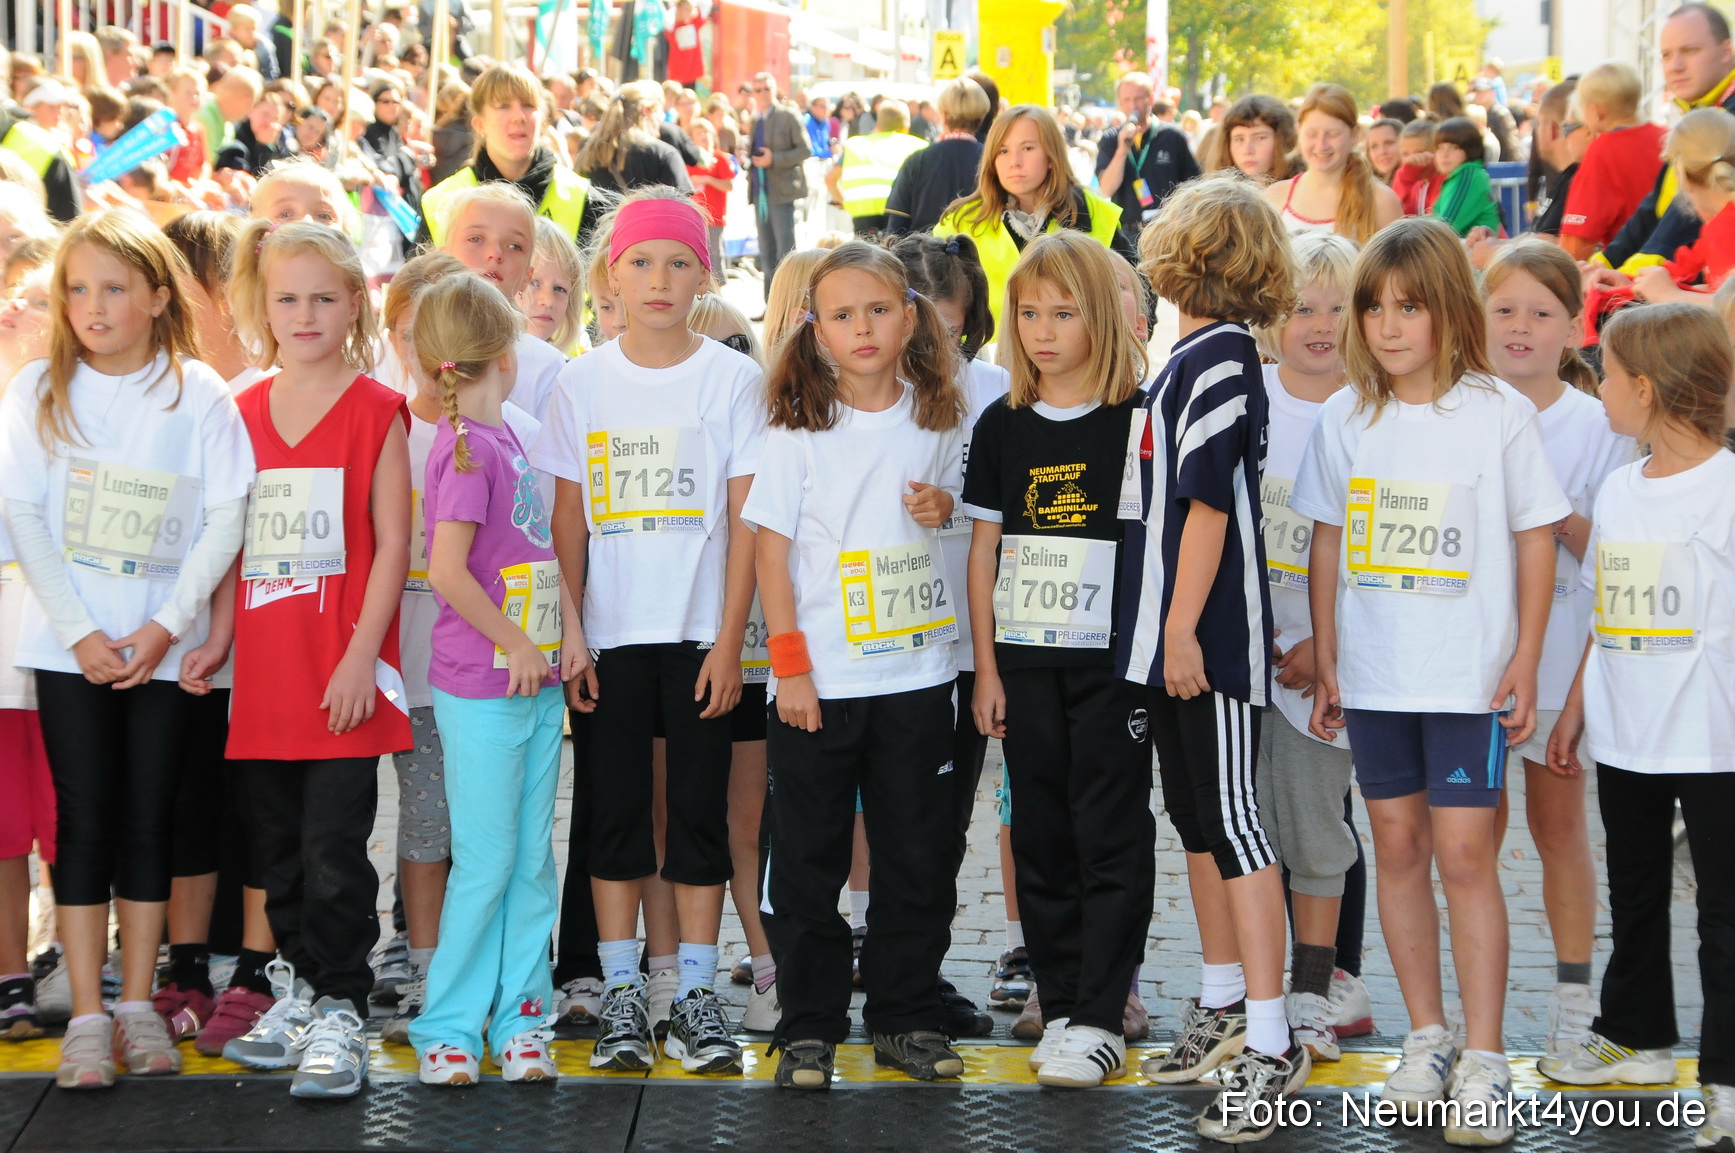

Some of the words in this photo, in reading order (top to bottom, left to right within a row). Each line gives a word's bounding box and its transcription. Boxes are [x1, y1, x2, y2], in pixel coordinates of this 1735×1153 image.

[941, 46, 957, 70] A
[612, 435, 659, 457] Sarah
[1029, 463, 1087, 476] NEUMARKTER
[102, 471, 169, 501] Luciana
[592, 471, 603, 487] K3
[615, 467, 697, 499] 7125
[1033, 472, 1081, 484] STADTLAUF
[68, 497, 85, 514] K3
[1379, 487, 1429, 511] Hanna
[1038, 504, 1099, 514] BAMBINILAUF
[100, 505, 182, 546] 7049
[258, 510, 330, 541] 7040
[657, 516, 704, 527] PFLEIDERER
[1351, 519, 1366, 535] K3
[1379, 522, 1462, 558] 7208
[291, 558, 342, 571] PFLEIDERER
[876, 551, 932, 577] Marlene
[1021, 546, 1068, 568] Selina
[1602, 550, 1630, 571] Lisa
[137, 562, 180, 575] PFLEIDERER
[998, 577, 1010, 592] K3
[1358, 575, 1385, 584] BOCK
[1416, 576, 1467, 589] PFLEIDERER
[848, 590, 866, 607] K3
[881, 577, 947, 618] 7192
[1021, 579, 1101, 613] 7087
[1605, 585, 1681, 617] 7110
[506, 603, 522, 617] K3
[923, 624, 957, 640] PFLEIDERER
[1058, 630, 1107, 641] PFLEIDERER
[862, 641, 896, 652] BOCK
[1643, 636, 1694, 647] PFLEIDERER
